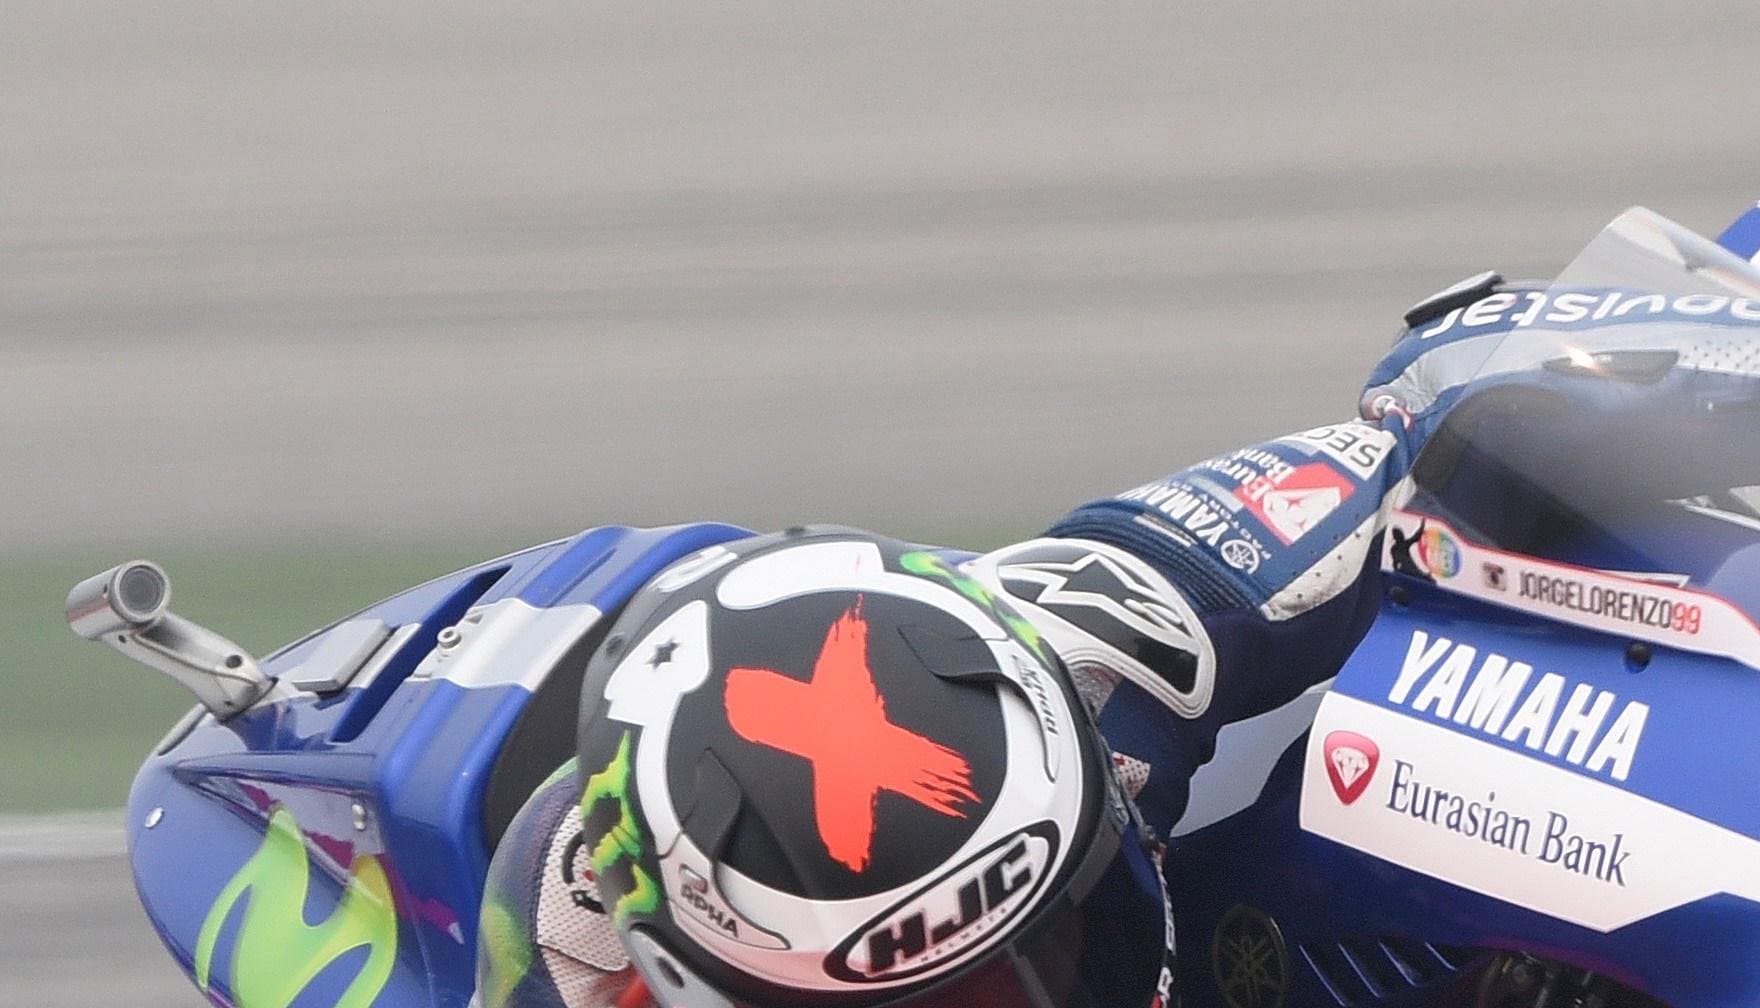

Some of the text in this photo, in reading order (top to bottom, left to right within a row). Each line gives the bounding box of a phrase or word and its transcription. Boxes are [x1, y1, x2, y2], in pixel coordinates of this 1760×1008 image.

[1112, 482, 1230, 548] YAMA
[1387, 629, 1651, 783] YAMAHA
[1385, 758, 1632, 888] Eurasian Bank
[867, 838, 1033, 974] HJC
